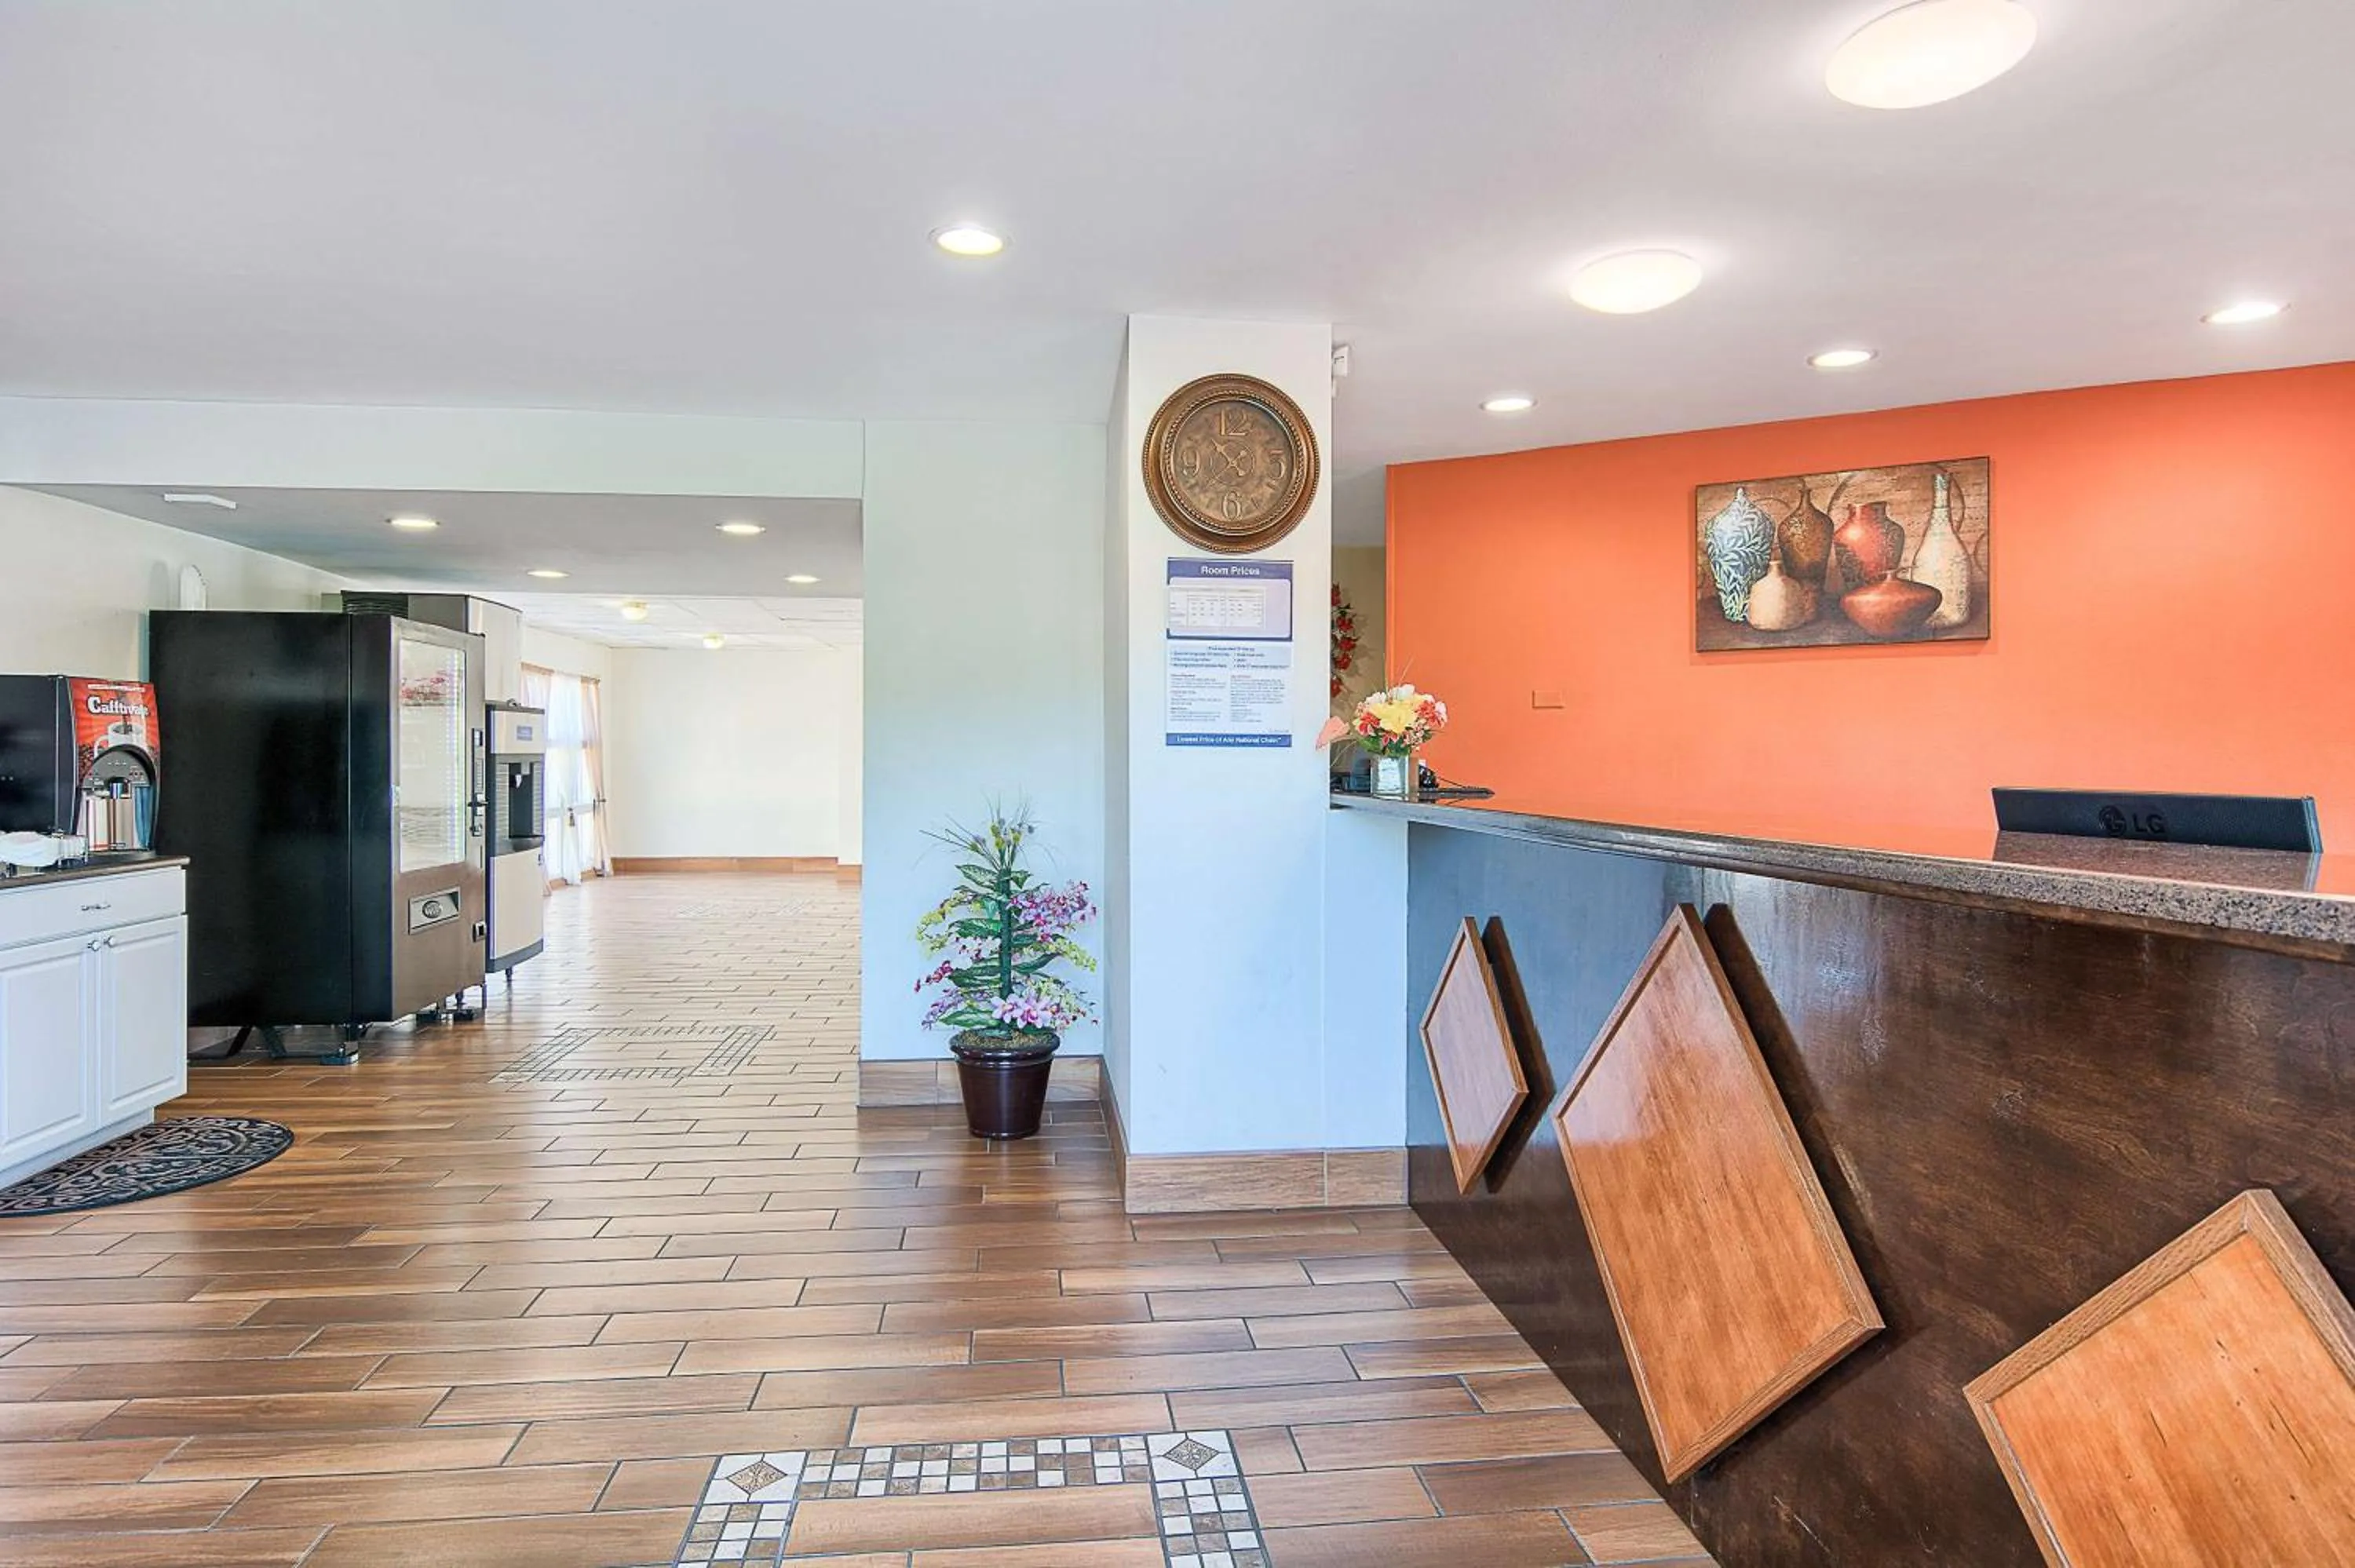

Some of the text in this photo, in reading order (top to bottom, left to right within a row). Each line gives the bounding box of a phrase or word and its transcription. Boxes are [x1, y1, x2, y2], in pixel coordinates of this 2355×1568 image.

[1219, 409, 1248, 436] 12
[1181, 447, 1201, 476] 9
[1268, 448, 1287, 480] 3
[1221, 490, 1243, 521] 6
[1201, 565, 1261, 576] Room Prices
[2132, 813, 2166, 834] LG
